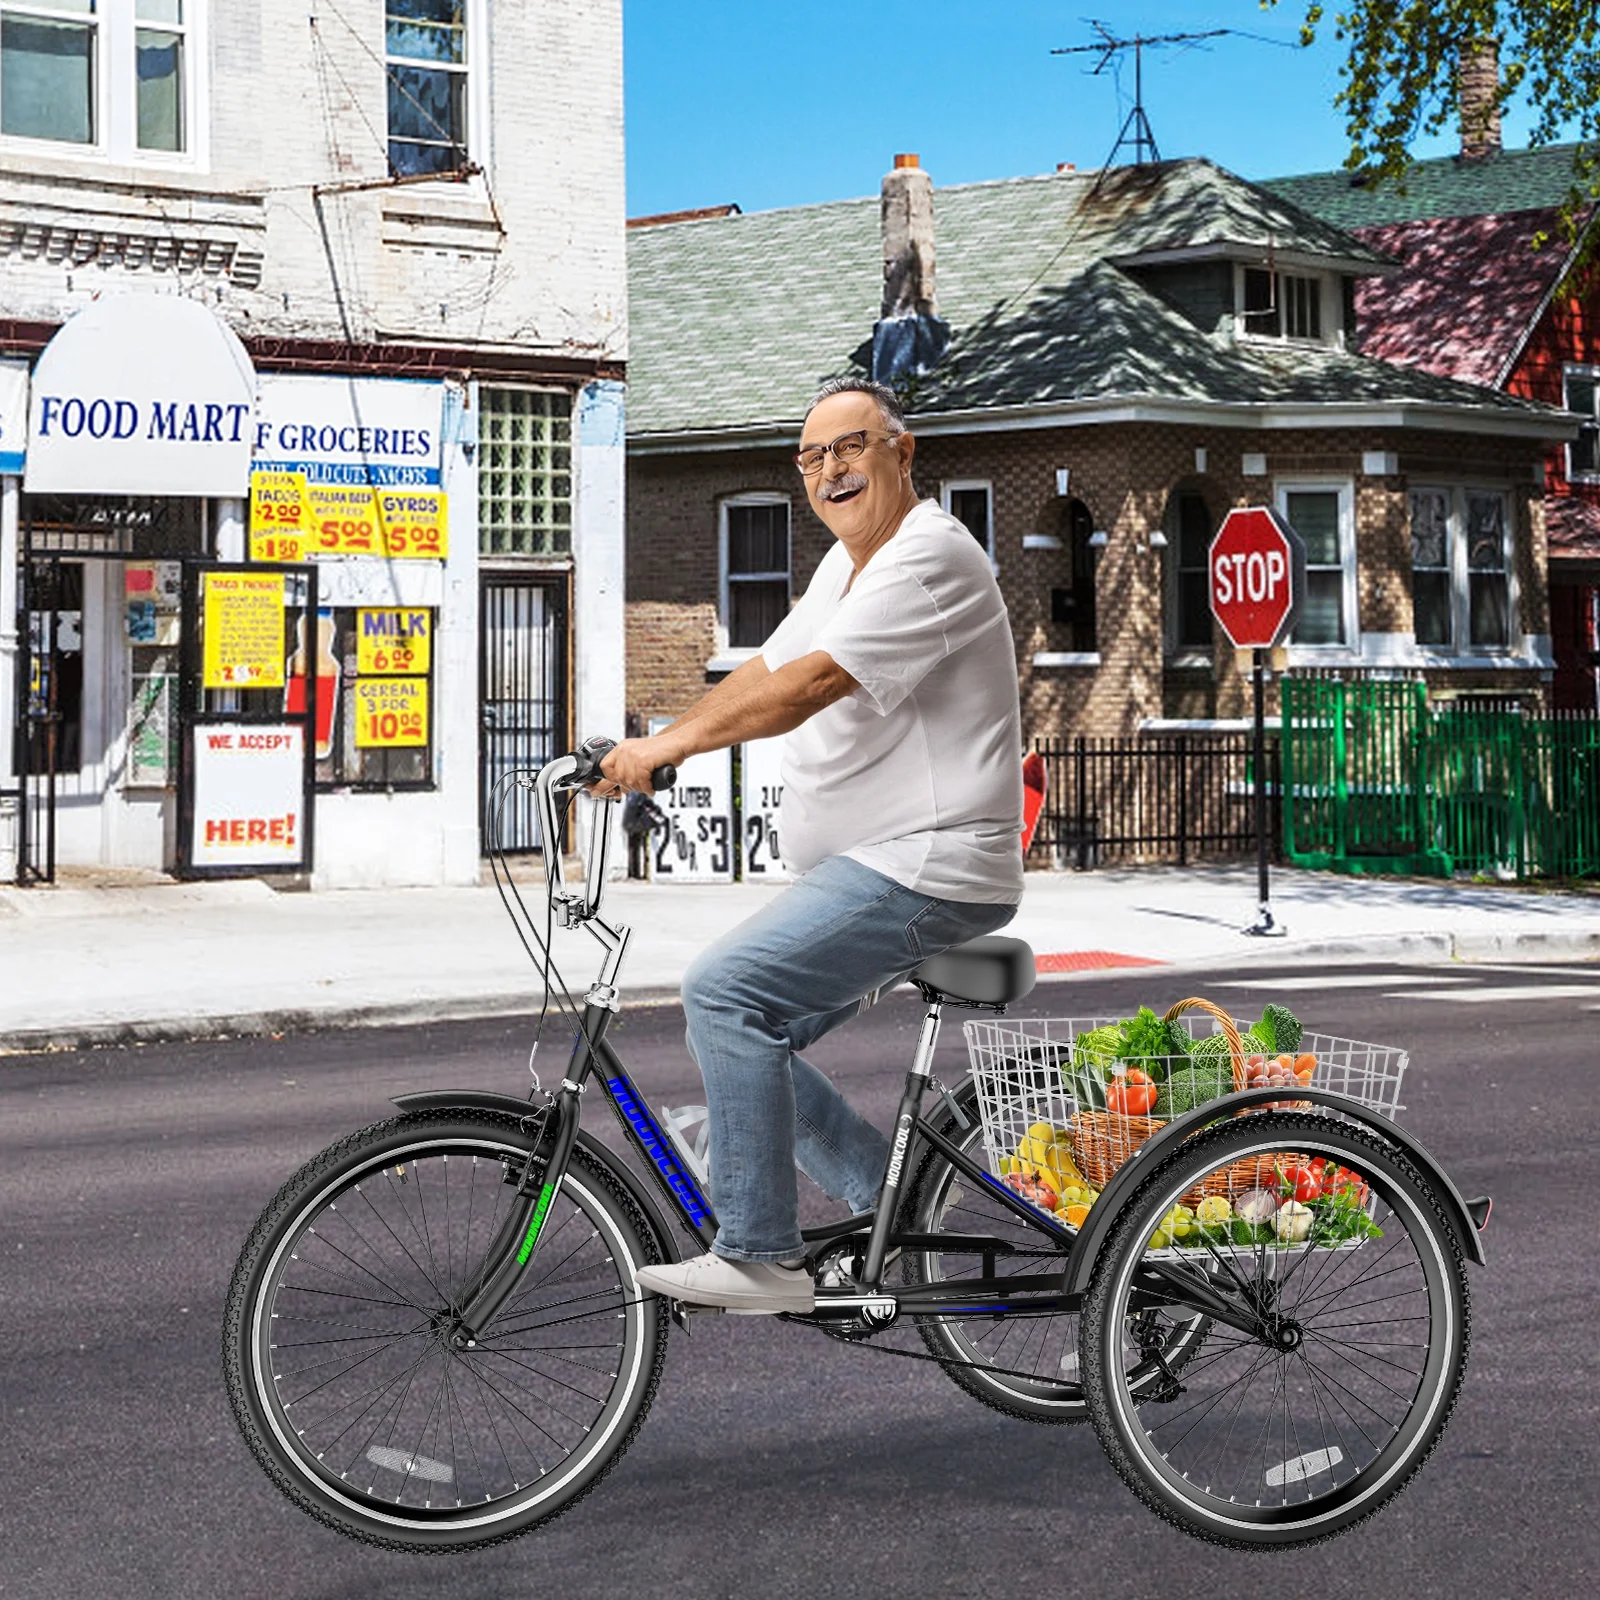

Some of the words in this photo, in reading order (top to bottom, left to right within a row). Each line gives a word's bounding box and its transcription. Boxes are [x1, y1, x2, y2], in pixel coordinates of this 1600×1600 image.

[39, 397, 138, 440] FOOD
[147, 401, 248, 443] MART
[280, 423, 431, 458] GROCERIES
[257, 489, 301, 502] TACOS
[383, 497, 438, 513] GYROS
[1215, 551, 1285, 604] STOP
[363, 612, 427, 637] MILK
[360, 684, 419, 697] CEREAL
[367, 700, 376, 713] 3
[380, 699, 410, 711] FOR
[207, 734, 232, 750] WE
[238, 735, 293, 750] ACCEPT
[669, 787, 675, 808] 2
[679, 787, 711, 808] LITER
[762, 787, 768, 808] 2
[205, 814, 295, 847] HERE!
[654, 815, 673, 873] 2
[748, 815, 766, 873] 2
[607, 1074, 712, 1228] MOONCOOL
[886, 1127, 910, 1188] MOONCOOL
[516, 1182, 554, 1266] MOONCOOL
